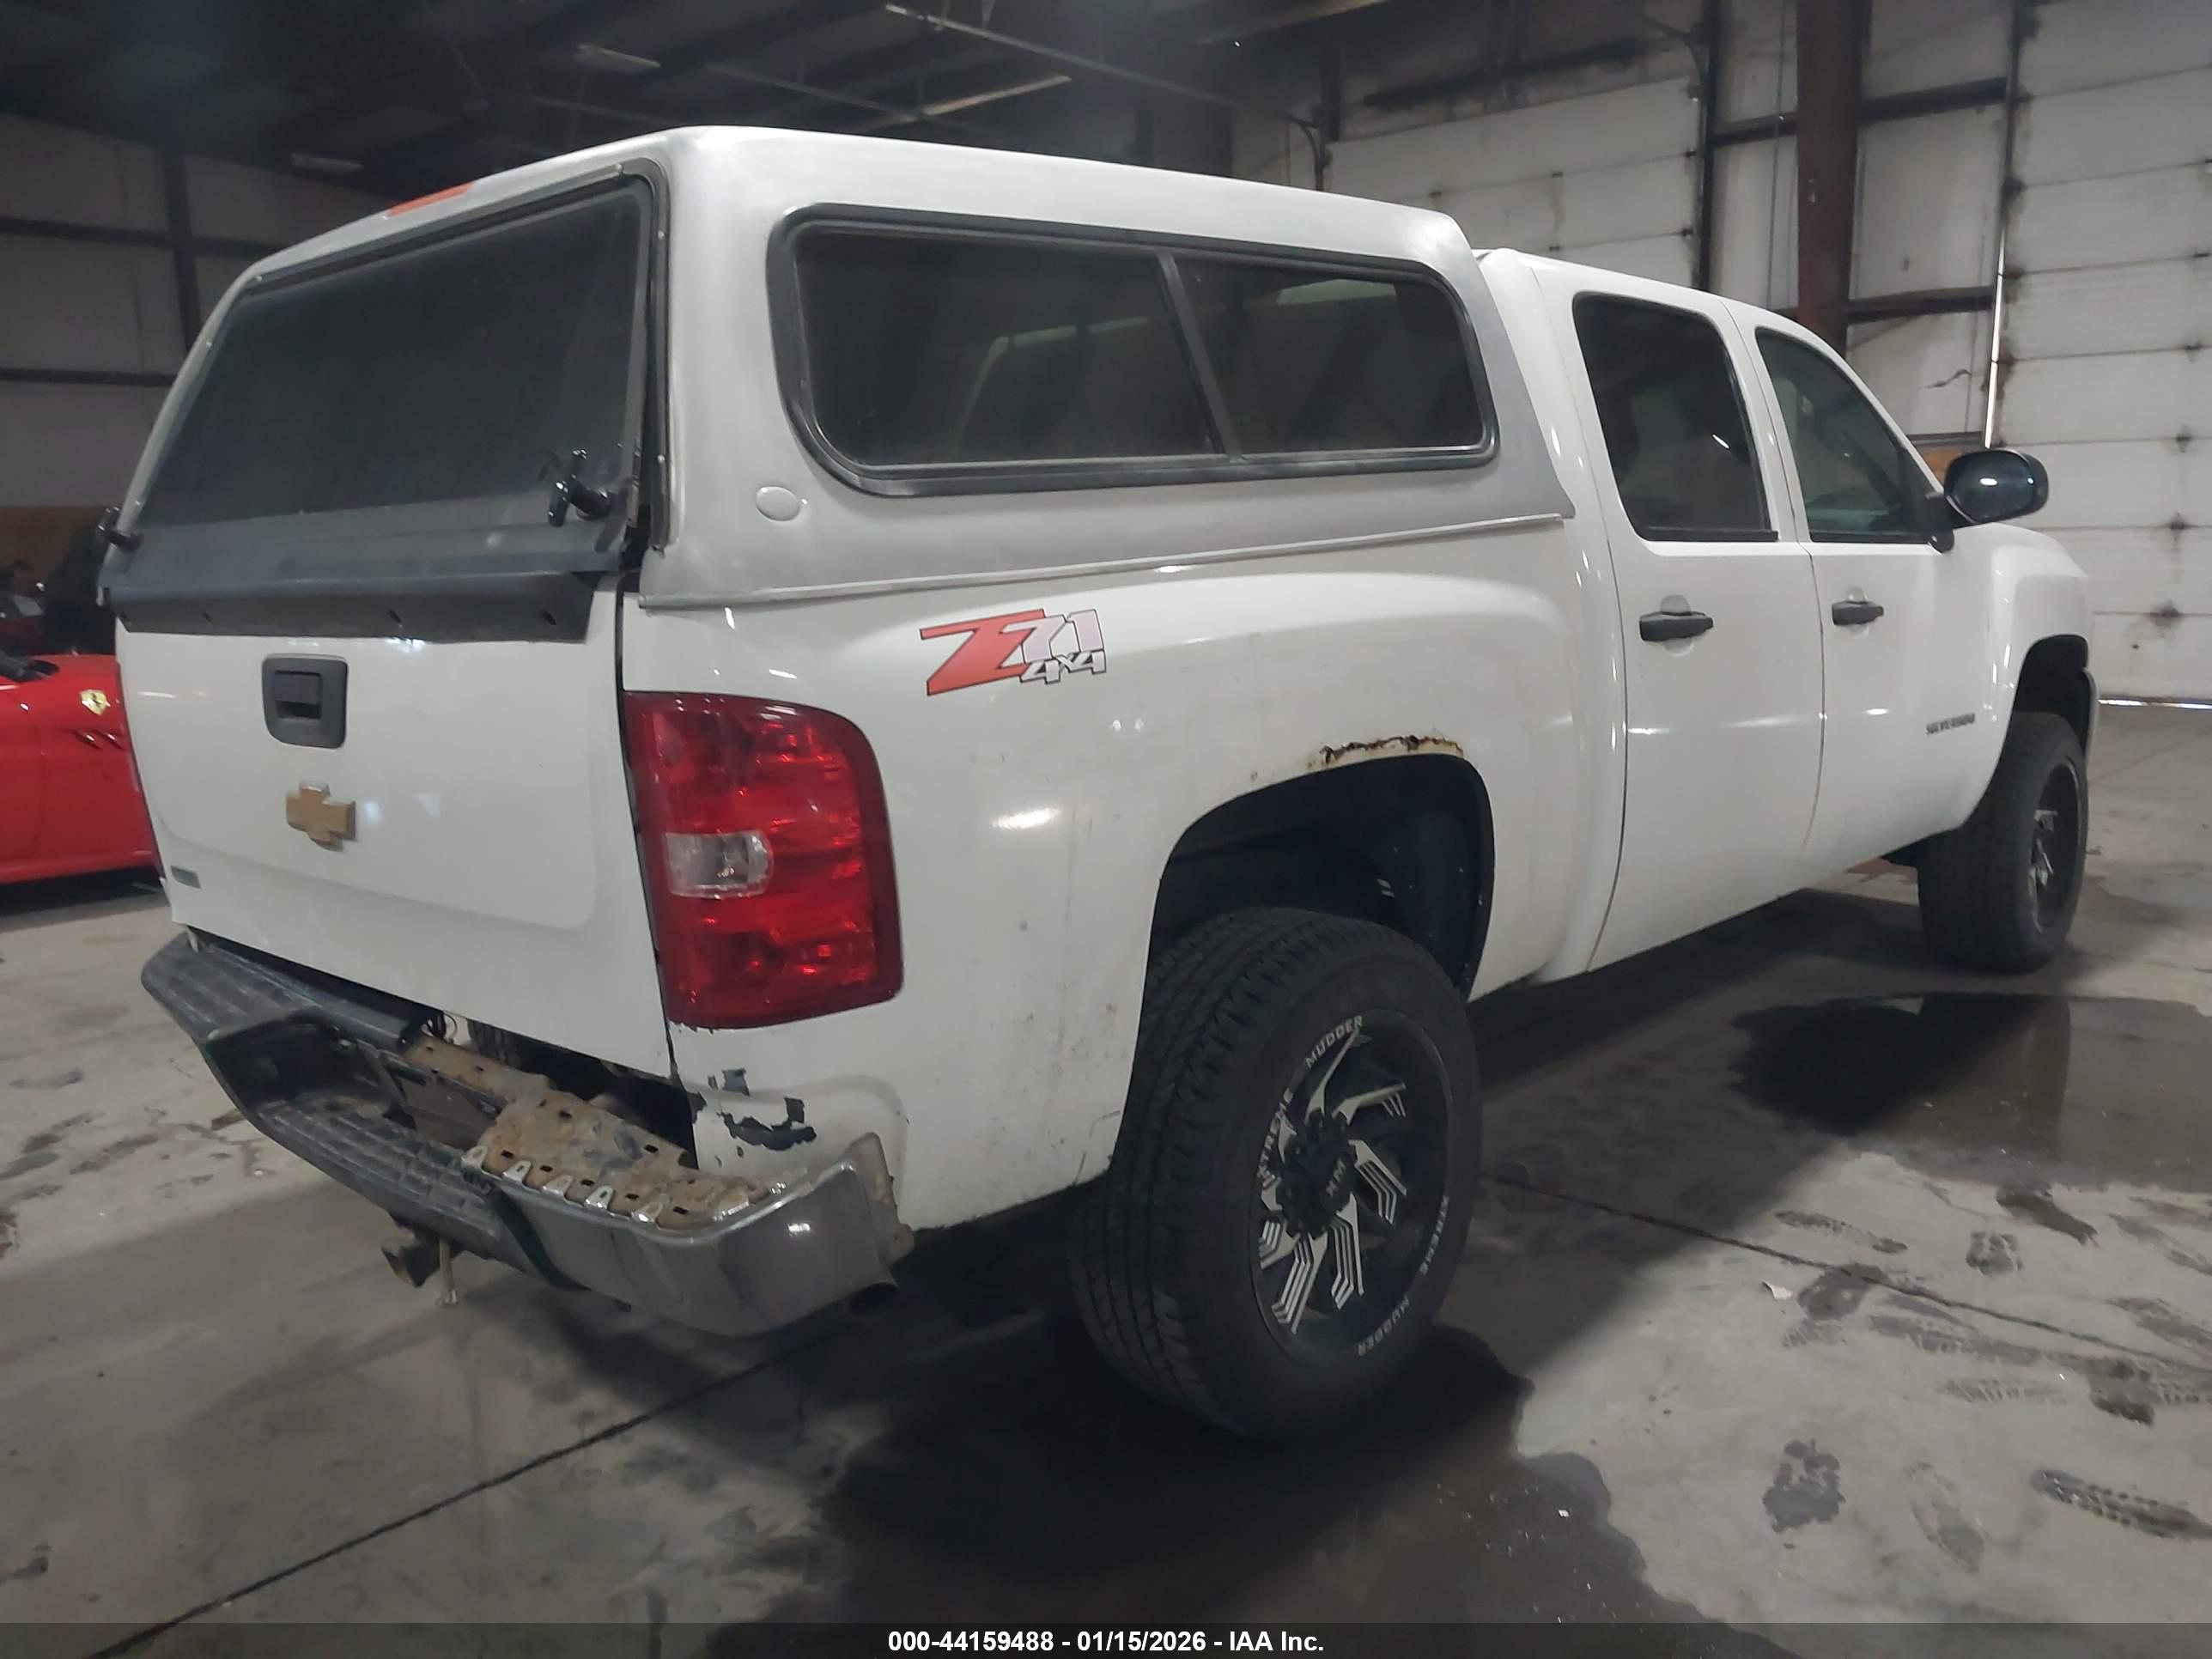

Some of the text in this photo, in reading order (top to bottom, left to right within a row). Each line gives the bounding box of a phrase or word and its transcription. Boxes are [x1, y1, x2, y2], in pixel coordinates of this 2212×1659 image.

[919, 608, 1104, 696] Z71
[1305, 1015, 1364, 1069] MUDDER
[1357, 1295, 1411, 1358] MUDDER
